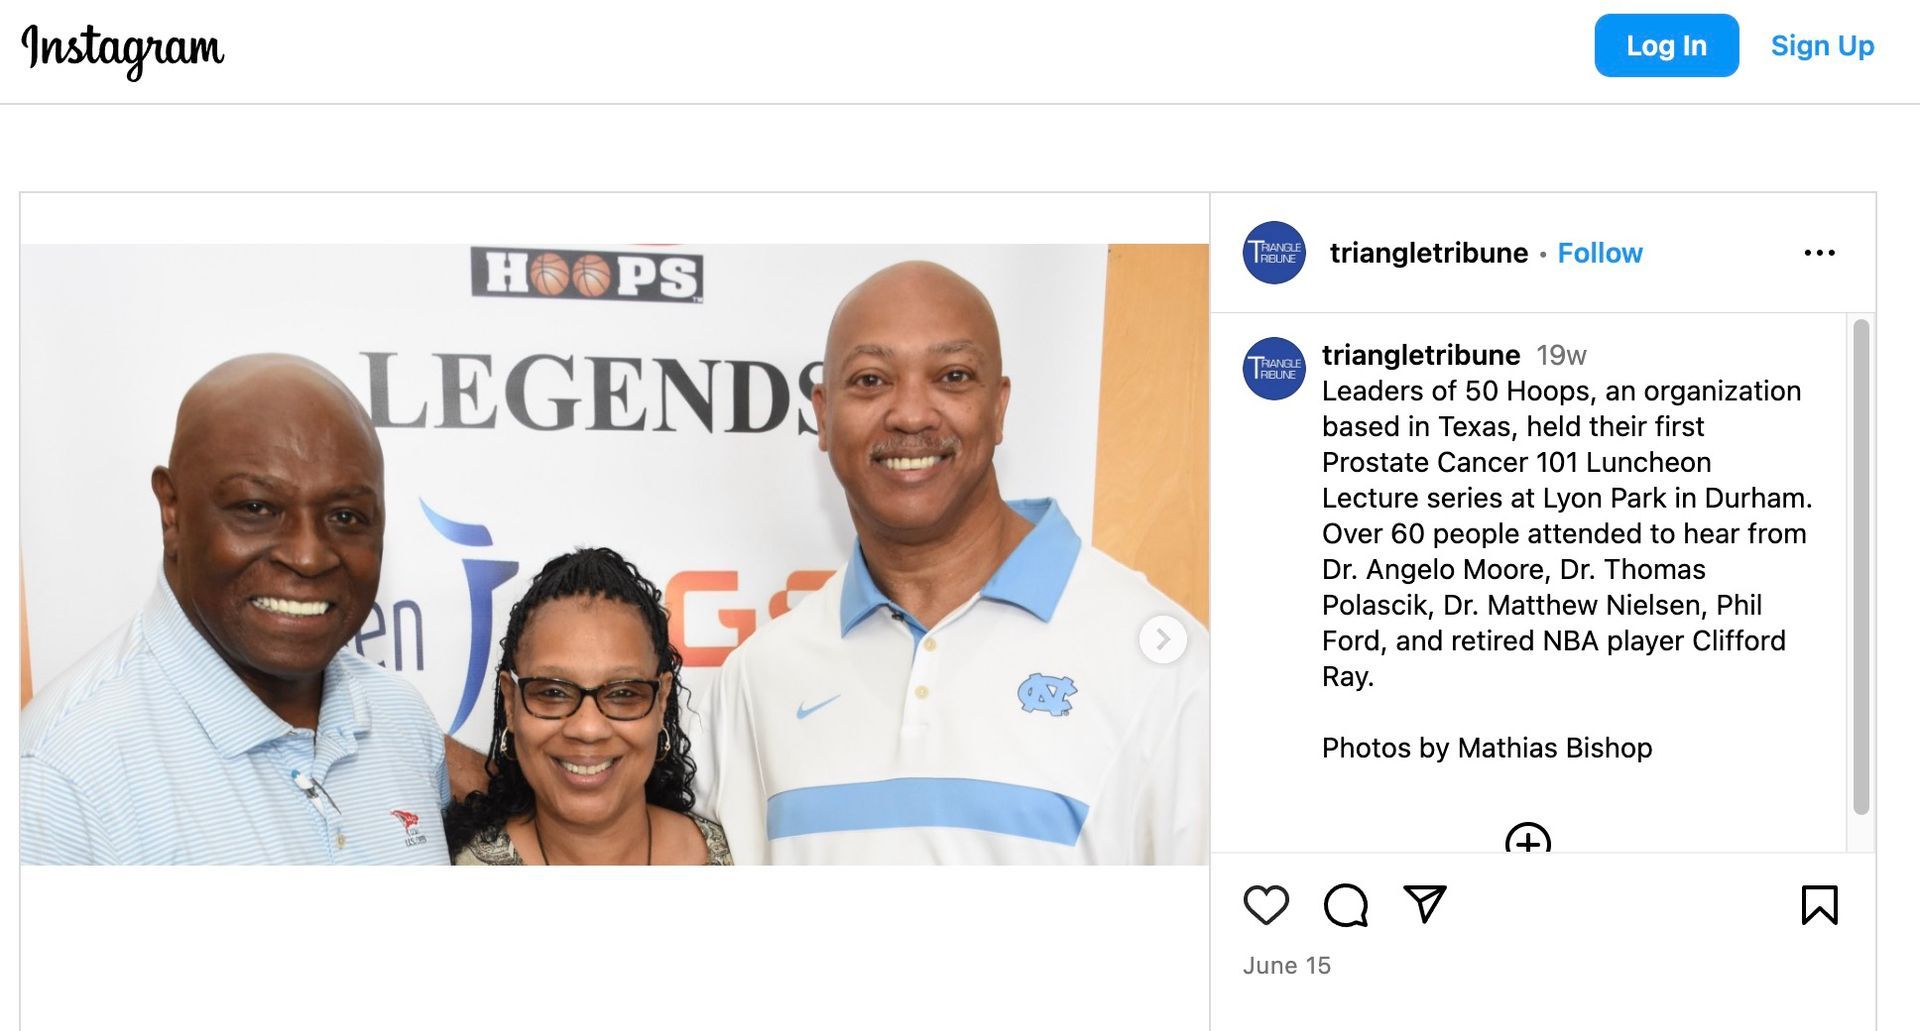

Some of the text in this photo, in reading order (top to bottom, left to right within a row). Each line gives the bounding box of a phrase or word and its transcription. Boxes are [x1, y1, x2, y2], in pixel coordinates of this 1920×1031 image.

[20, 23, 226, 83] Instagram
[1627, 34, 1707, 62] Log In
[1771, 32, 1876, 62] Sign Up
[1329, 240, 1644, 269] triangletribune Follow
[486, 252, 698, 298] HOOPS
[1321, 342, 1588, 371] triangletribune 19w
[1323, 378, 1801, 407] Leaders of 50 Hoops, an organization
[1323, 414, 1705, 442] based in Texas, held their first
[1323, 450, 1712, 474] Prostate Cancer 101 Luncheon
[1323, 485, 1812, 514] Lecture series at Lyon Park in Durham.
[1322, 521, 1807, 549] Over 60 people attended to hear from
[1323, 557, 1706, 585] Dr. Angelo Moore, Dr. Thomas
[1323, 592, 1762, 621] Polascik, Dr. Matthew Nielsen, Phil
[1323, 628, 1786, 657] Ford, and retired NBA player Clifford
[1323, 665, 1374, 692] Ray.
[1323, 735, 1653, 764] Photos by Mathias Bishop
[1242, 955, 1332, 975] June 15
